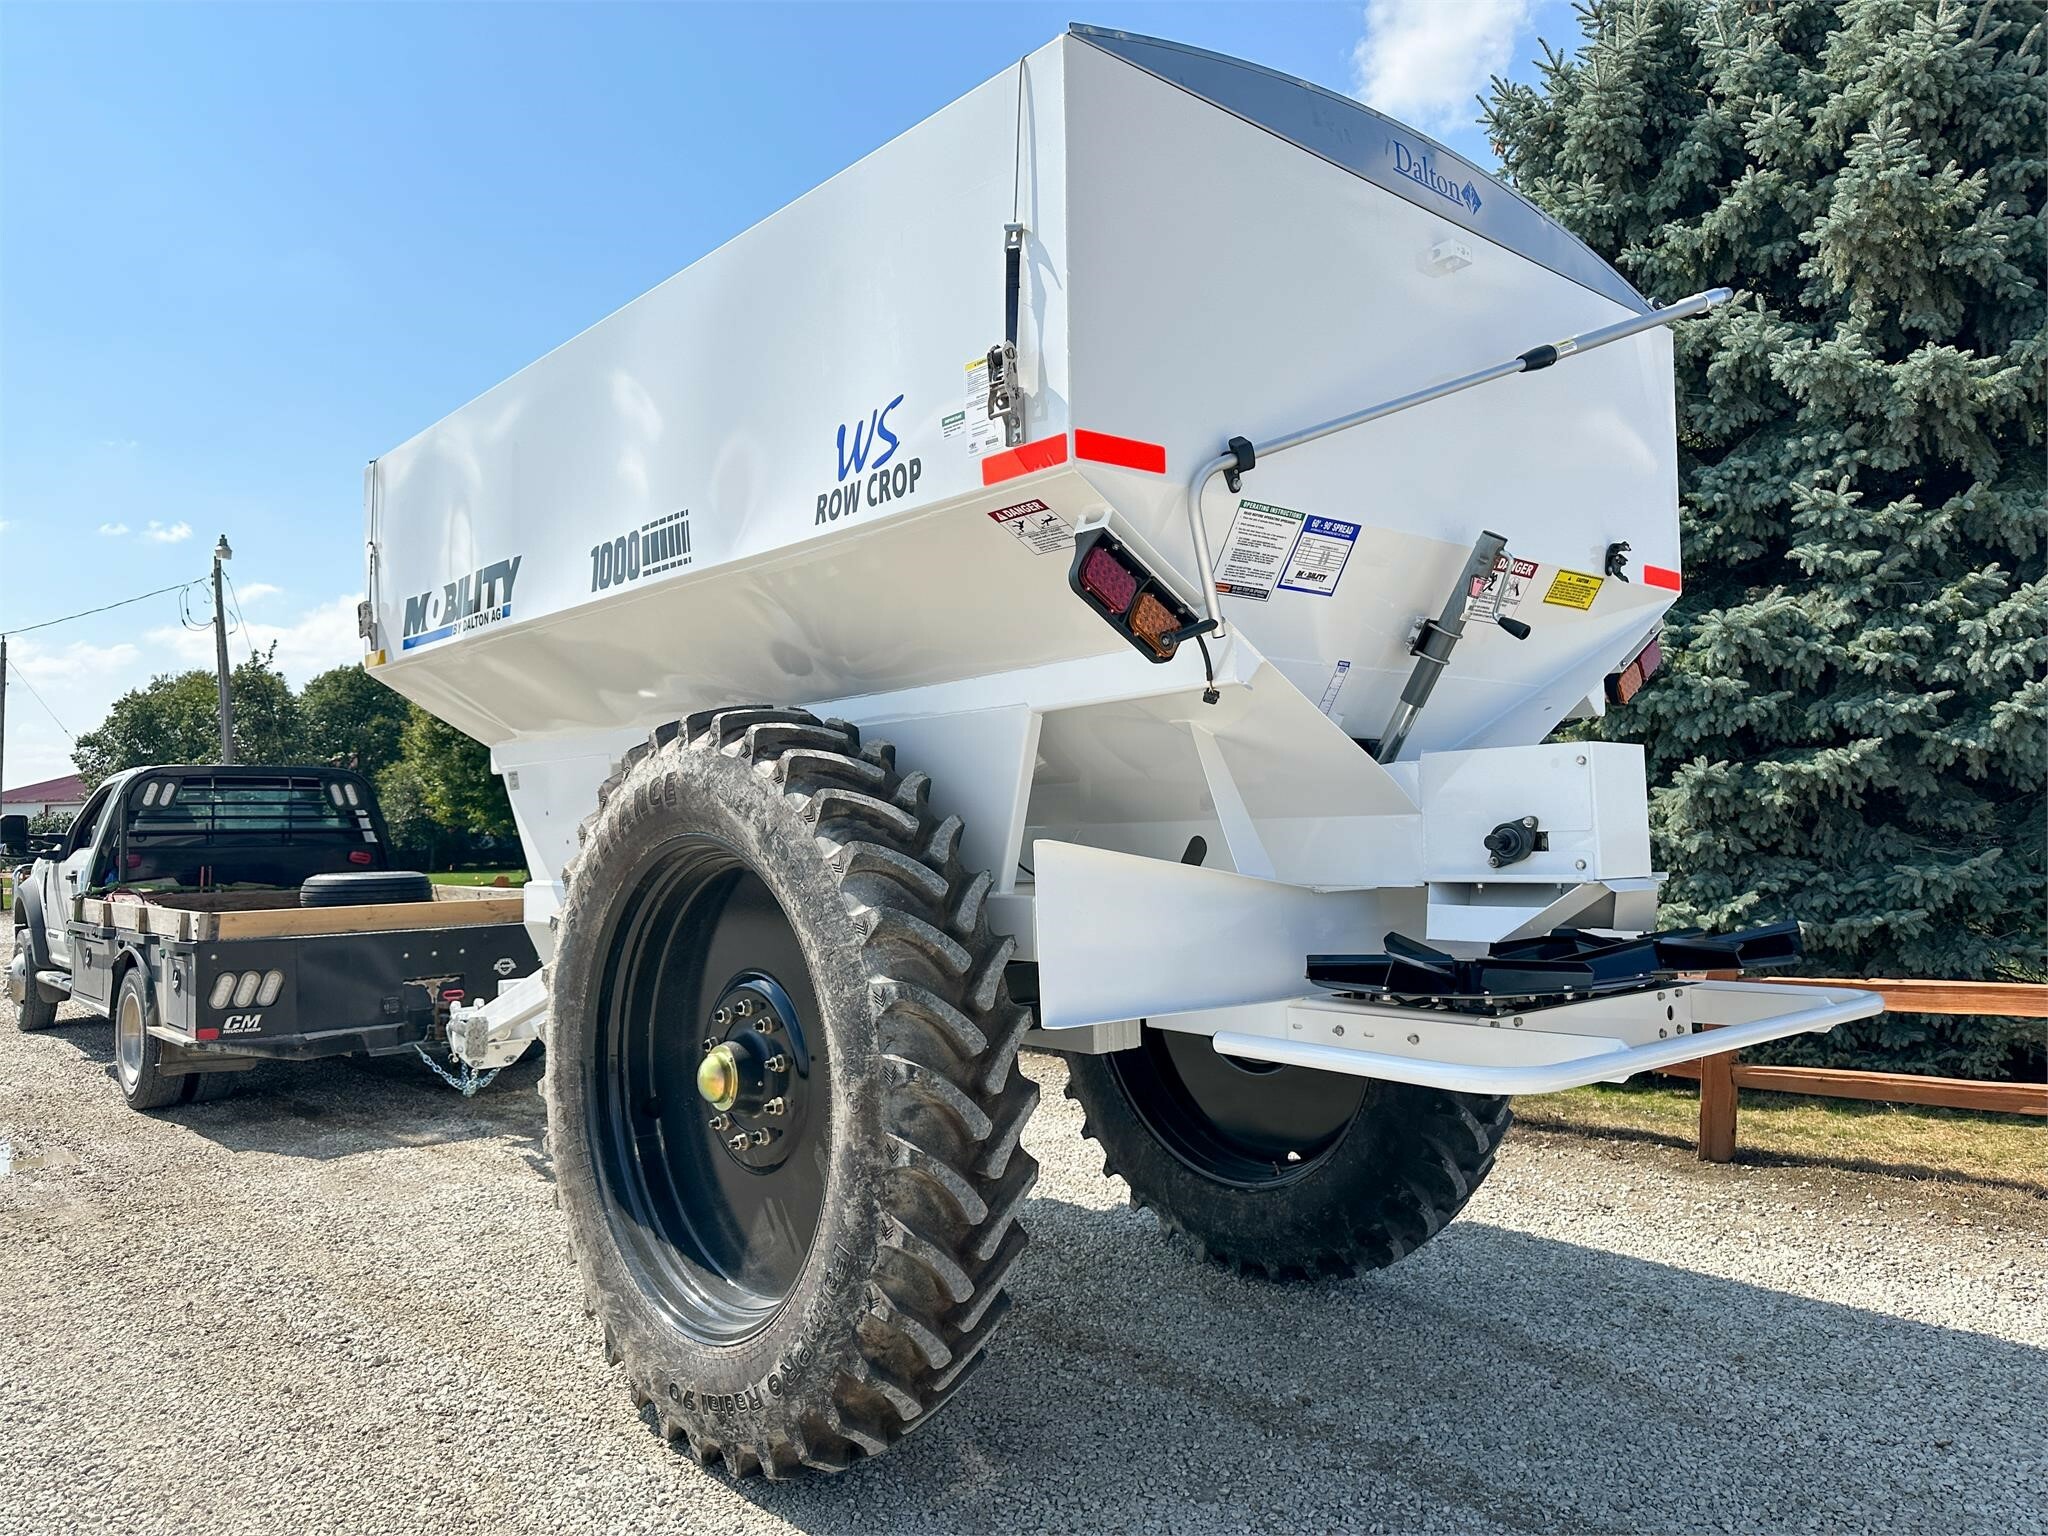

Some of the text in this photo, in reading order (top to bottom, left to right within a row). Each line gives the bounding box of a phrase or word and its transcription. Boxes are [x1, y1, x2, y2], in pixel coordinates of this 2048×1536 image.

[1392, 139, 1463, 205] Dalton
[836, 394, 904, 482] WS
[815, 457, 922, 526] ROW CROP
[1002, 501, 1044, 518] DANGER
[1243, 501, 1303, 519] OPERATING INSTRUCTIONS
[1332, 522, 1354, 535] SPREAD
[590, 529, 640, 593] 1000
[1295, 570, 1328, 581] MOBILITY
[403, 554, 522, 637] MOBILITY
[453, 607, 501, 635] BY DALTON AG
[223, 1014, 262, 1029] CM
[669, 1381, 697, 1411] 90
[702, 1385, 764, 1418] Radial
